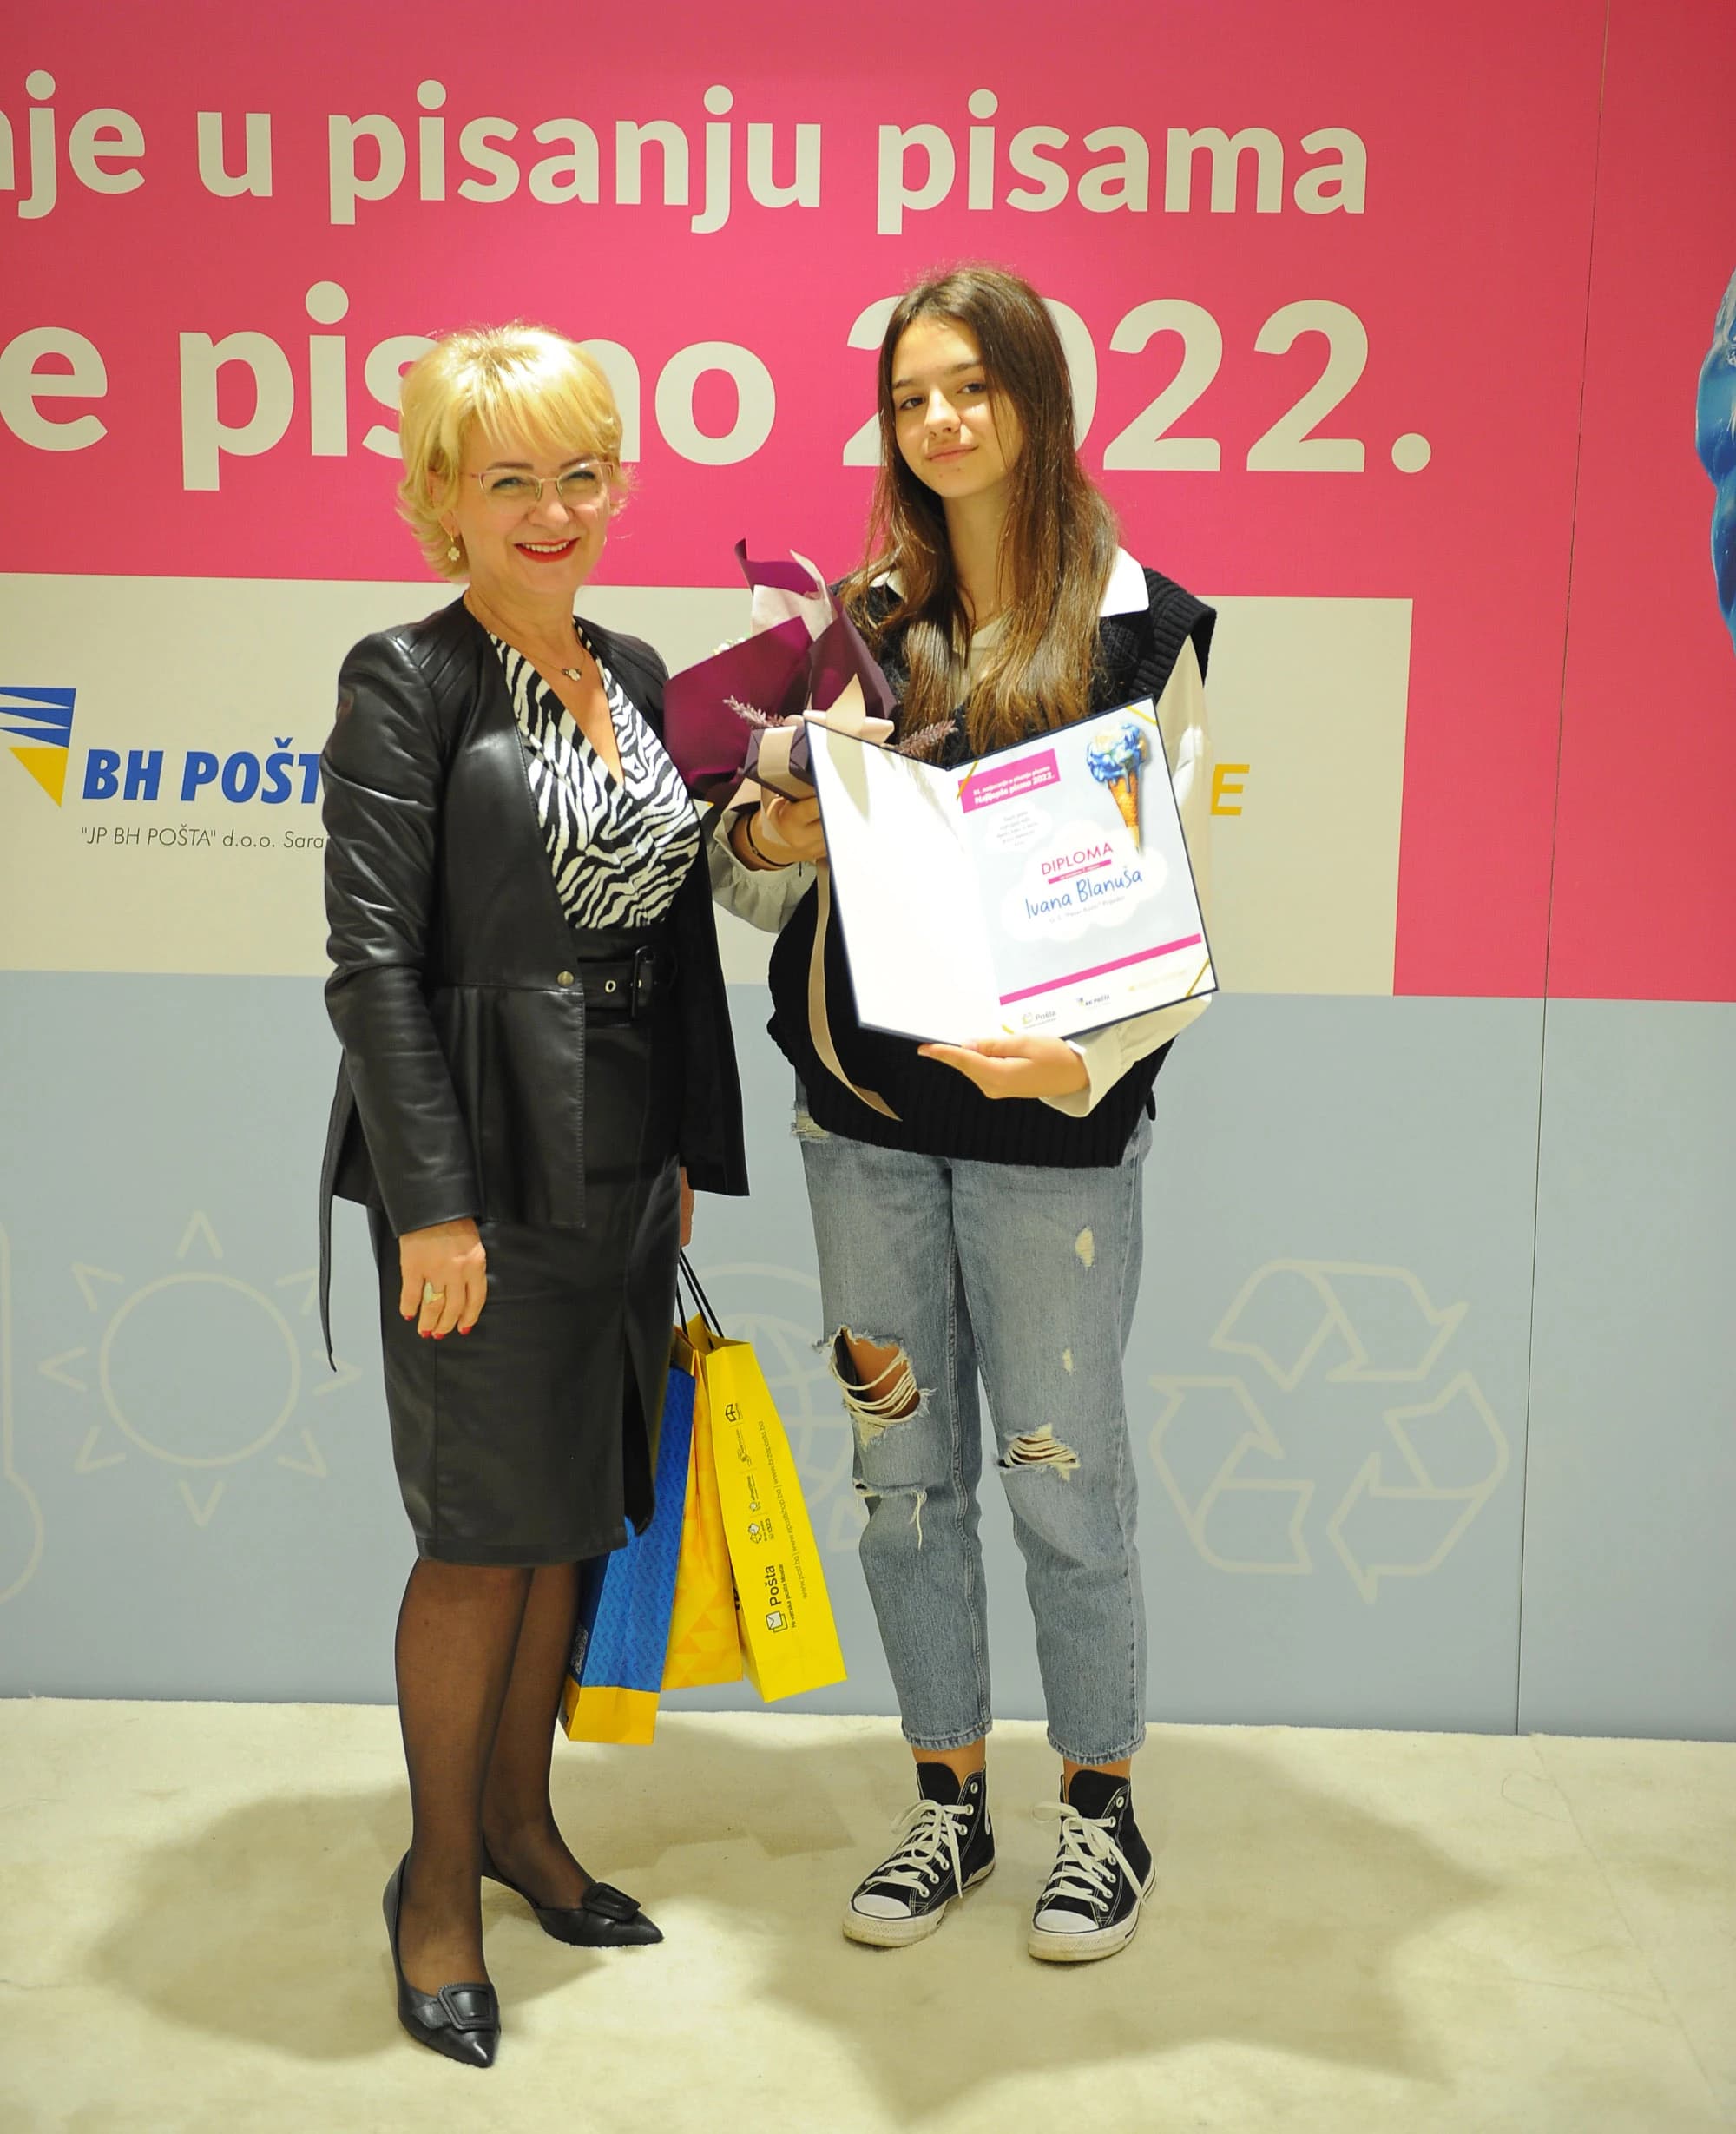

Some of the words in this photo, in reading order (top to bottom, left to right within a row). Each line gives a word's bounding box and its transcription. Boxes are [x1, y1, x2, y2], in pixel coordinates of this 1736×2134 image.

[0, 69, 146, 220] je
[196, 111, 273, 198] u
[329, 80, 821, 234] pisanju
[877, 89, 1367, 234] pisama
[82, 749, 164, 800] BH
[1210, 763, 1250, 816] E
[82, 827, 108, 846] "JP
[114, 828, 141, 846] BH
[148, 824, 216, 847] POŠTA"
[223, 830, 275, 849] d.o.o.
[284, 830, 325, 849] Sara
[1041, 842, 1114, 875] DIPLOMA
[1025, 892, 1072, 919] Ivana
[1075, 866, 1143, 904] Blanuša
[765, 1564, 781, 1606] Pošta
